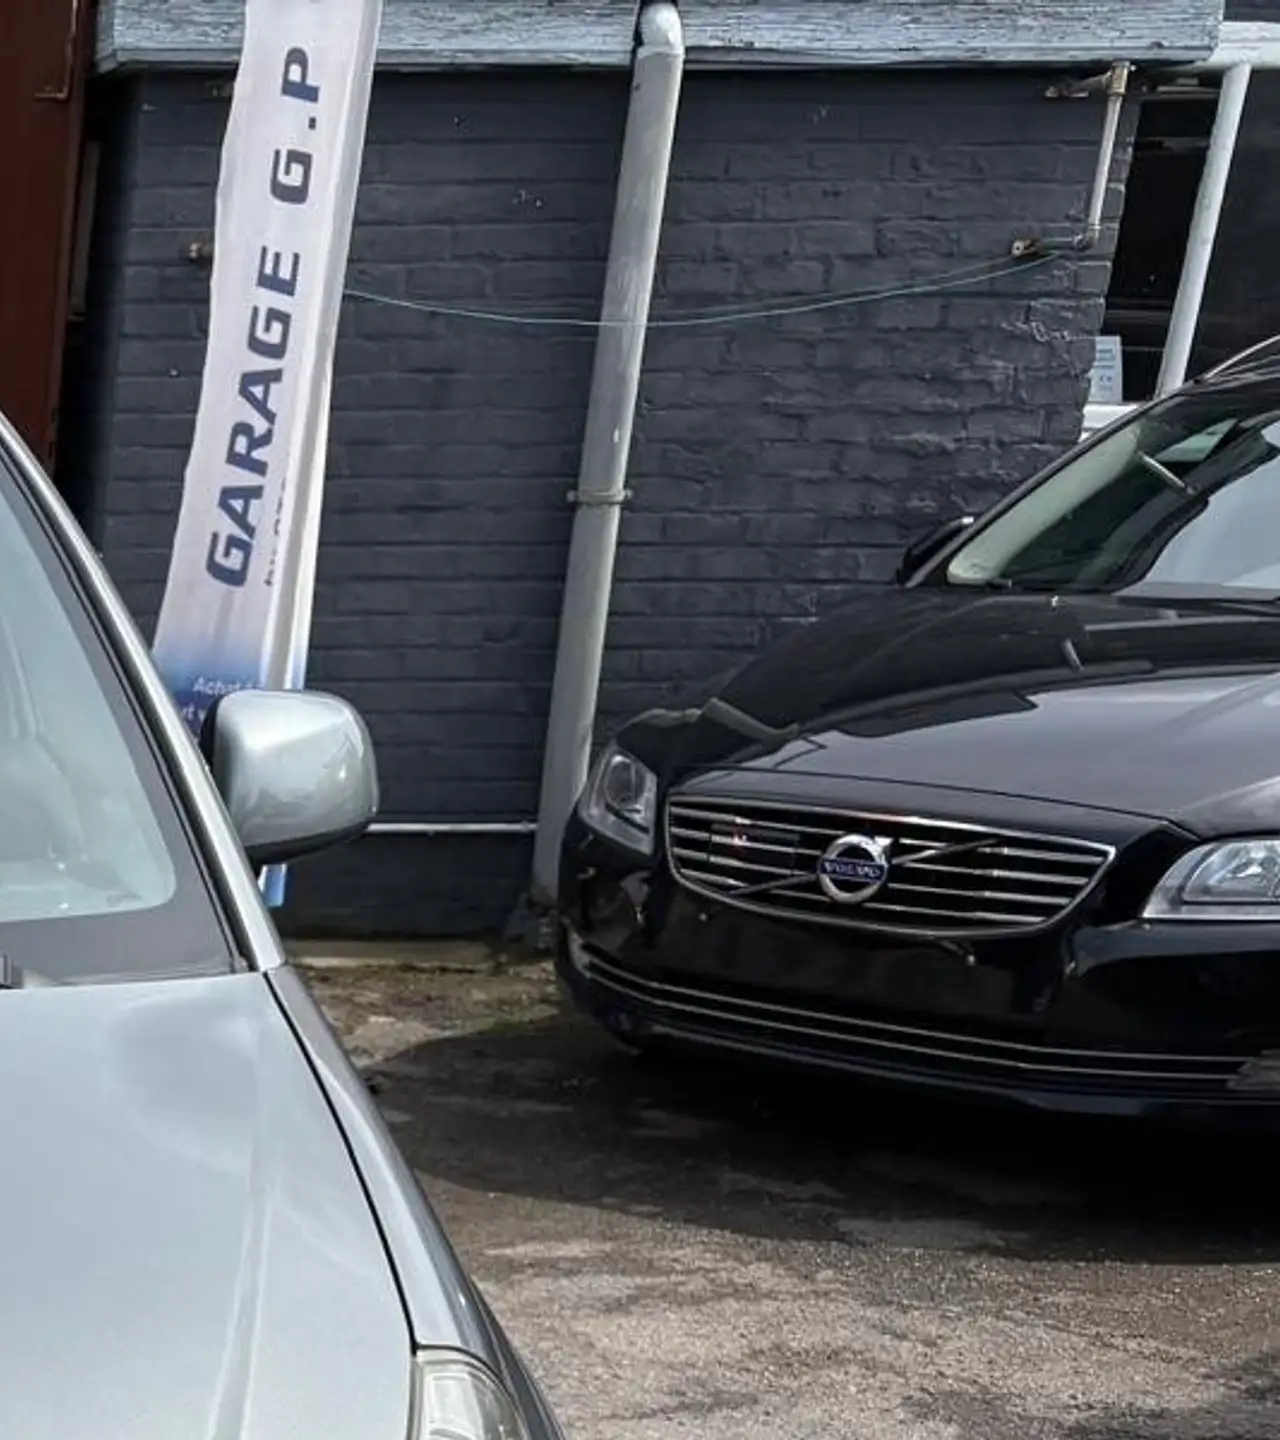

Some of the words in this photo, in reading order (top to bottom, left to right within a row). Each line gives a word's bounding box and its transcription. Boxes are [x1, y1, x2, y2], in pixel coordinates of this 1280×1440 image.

[206, 245, 301, 588] GARAGE
[270, 47, 321, 205] G.P
[824, 861, 881, 877] VOLVO
